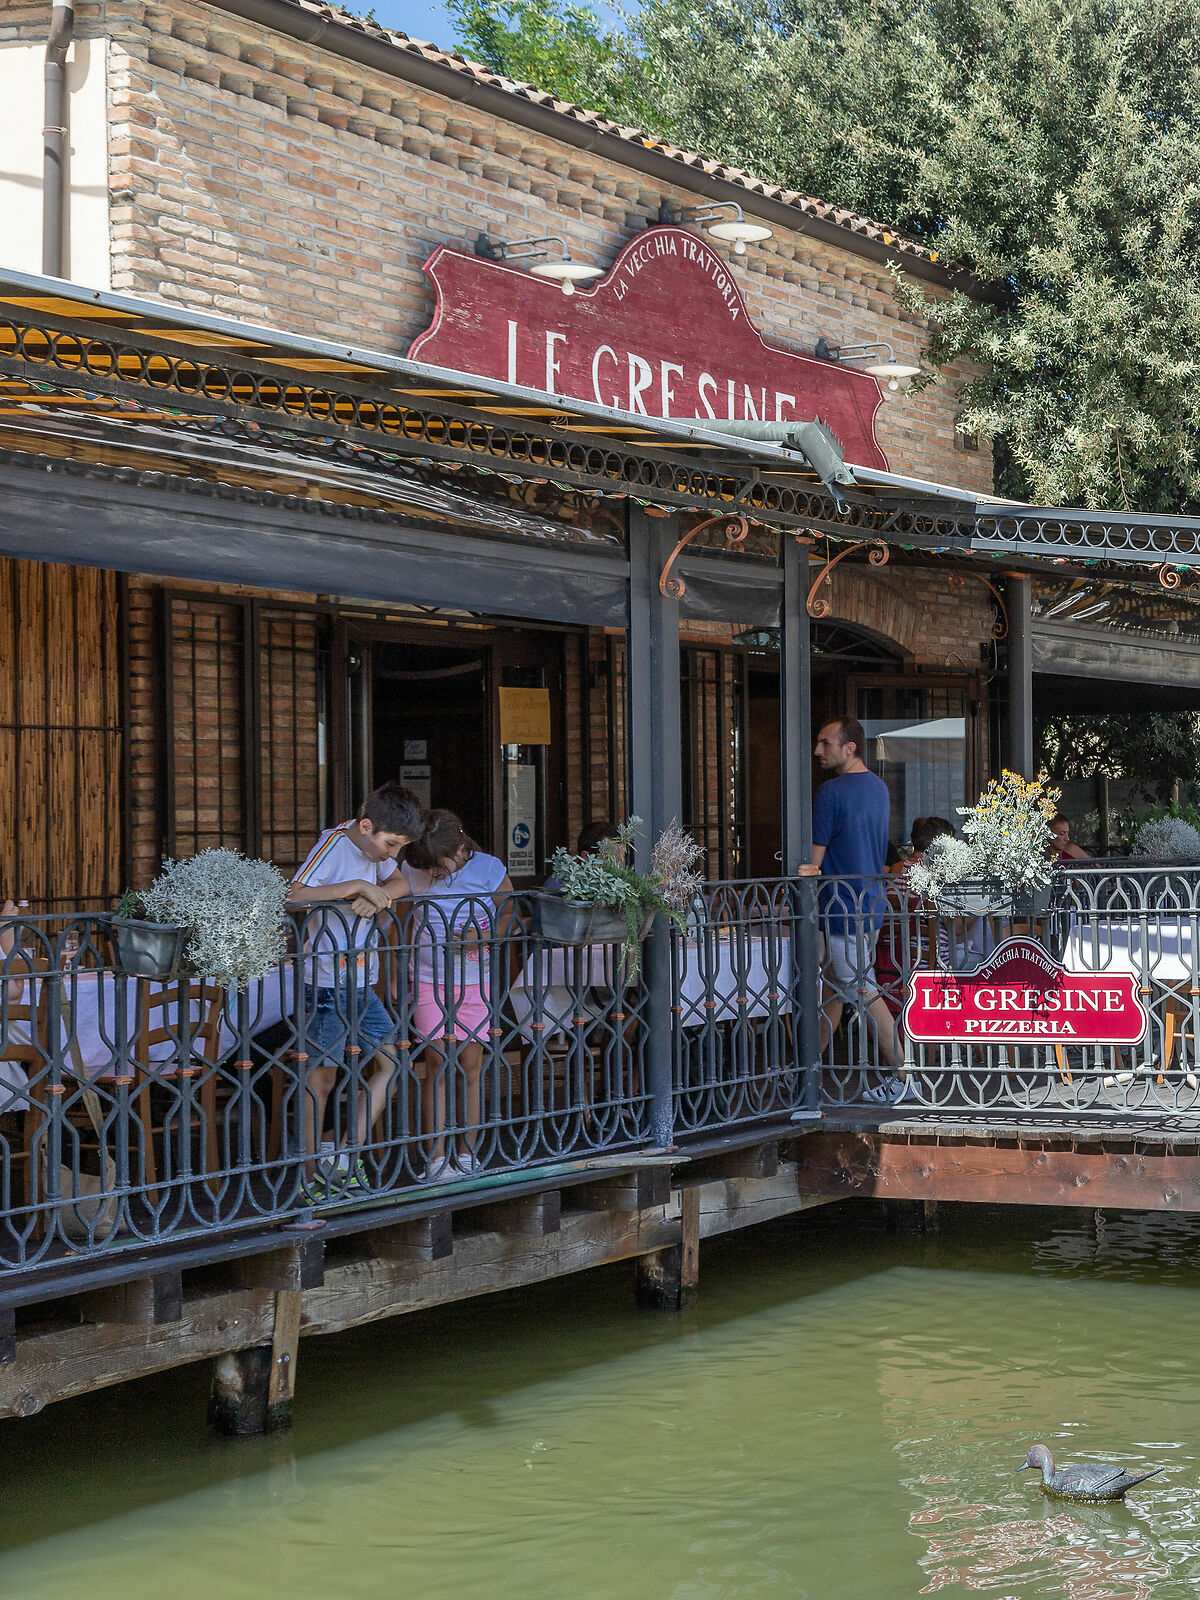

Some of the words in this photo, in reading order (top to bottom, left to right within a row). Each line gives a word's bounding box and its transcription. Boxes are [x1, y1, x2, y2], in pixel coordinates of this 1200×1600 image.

[613, 279, 629, 301] LA
[624, 235, 677, 277] VECCHIA
[681, 237, 739, 321] TRATTORIA
[507, 320, 570, 396] LE
[592, 344, 796, 422] GRESINE
[981, 968, 993, 979] LA
[990, 947, 1020, 970] VECCHIA
[1021, 947, 1058, 979] TRATTORIA
[922, 989, 962, 1010] LE
[974, 989, 1125, 1012] GRESINE
[964, 1020, 1077, 1034] PIZZERIA
